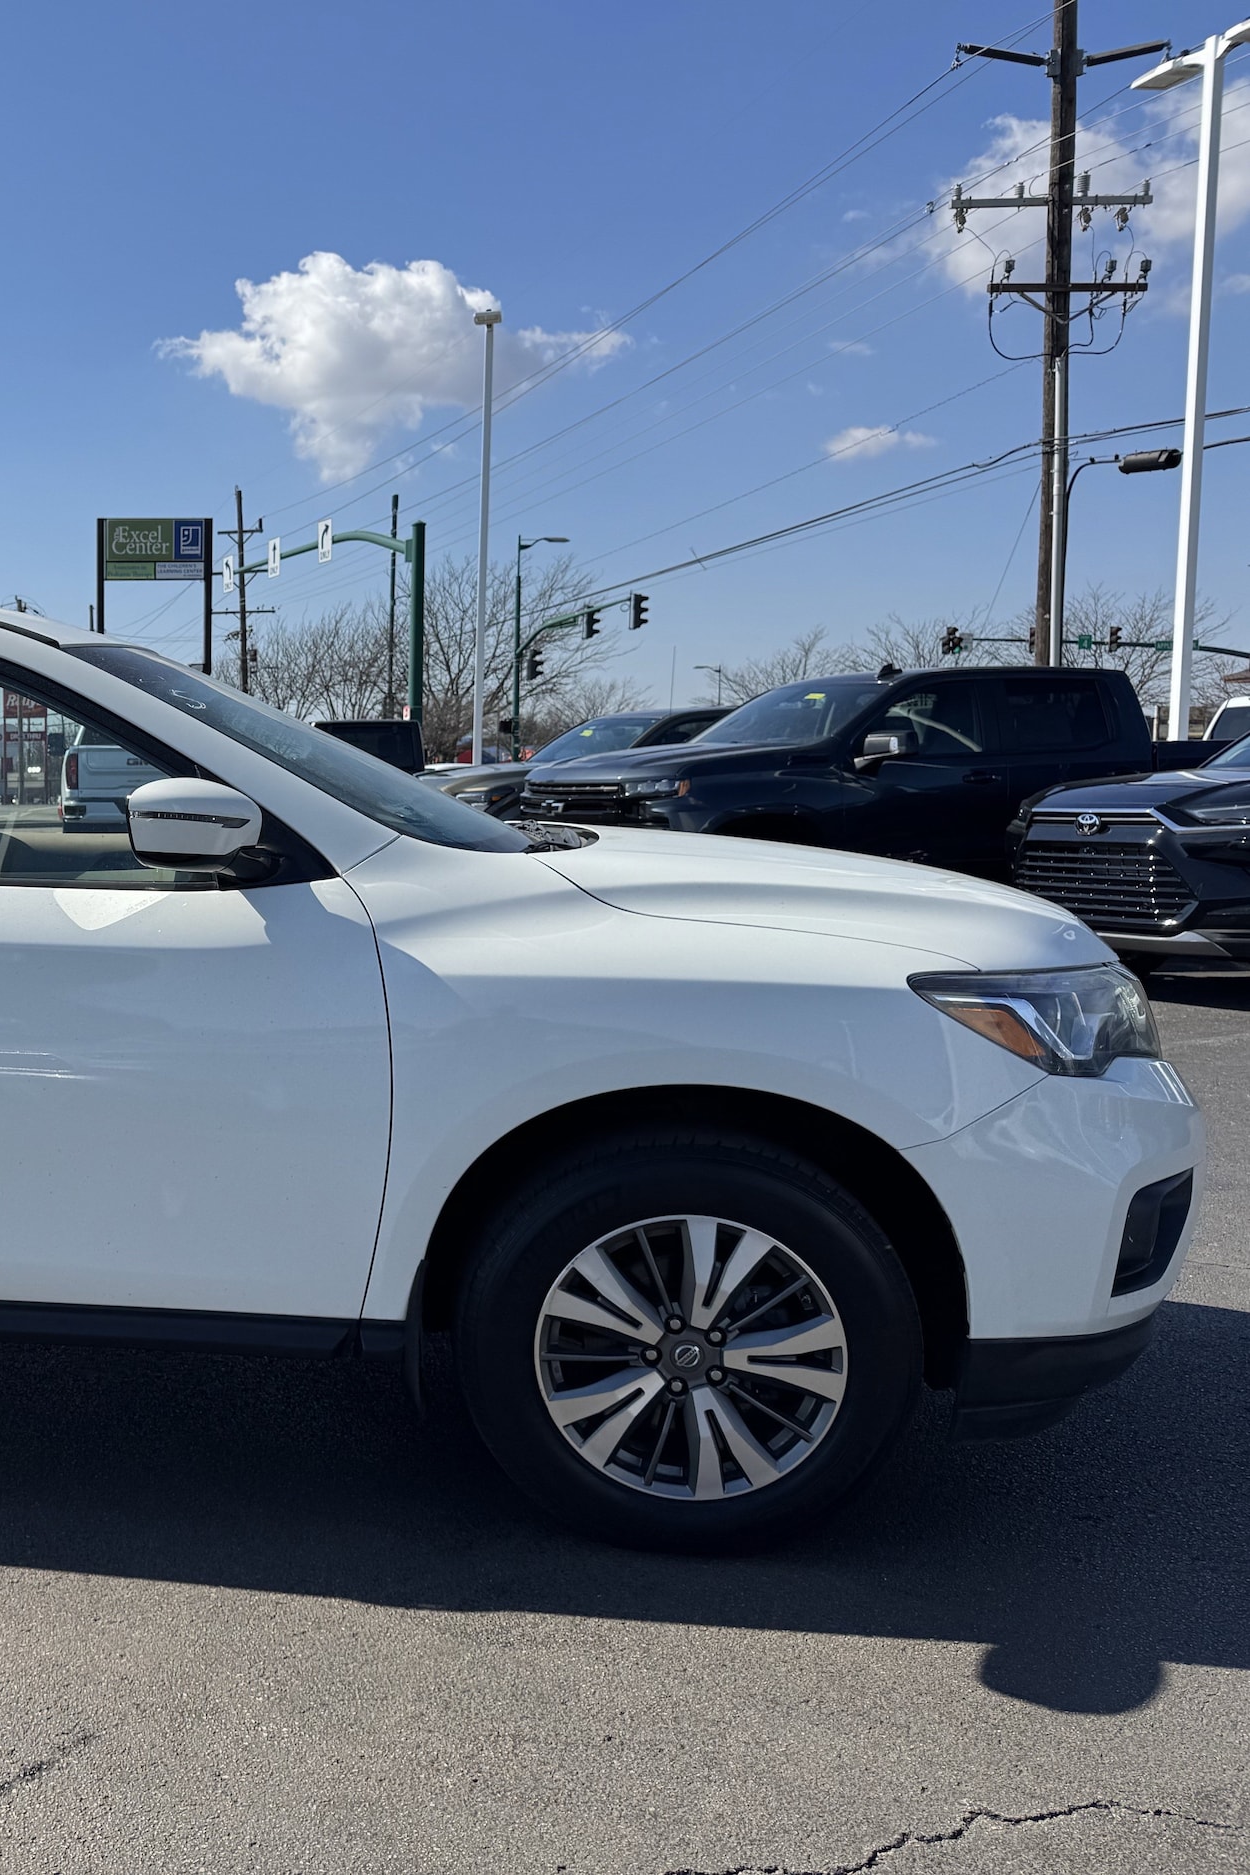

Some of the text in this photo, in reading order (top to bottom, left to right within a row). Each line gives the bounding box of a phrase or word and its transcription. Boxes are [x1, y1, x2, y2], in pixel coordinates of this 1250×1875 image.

[118, 525, 162, 543] Excel
[111, 540, 169, 555] Center
[320, 549, 330, 561] ONLY
[1082, 640, 1089, 649] 4
[126, 758, 149, 766] GM
